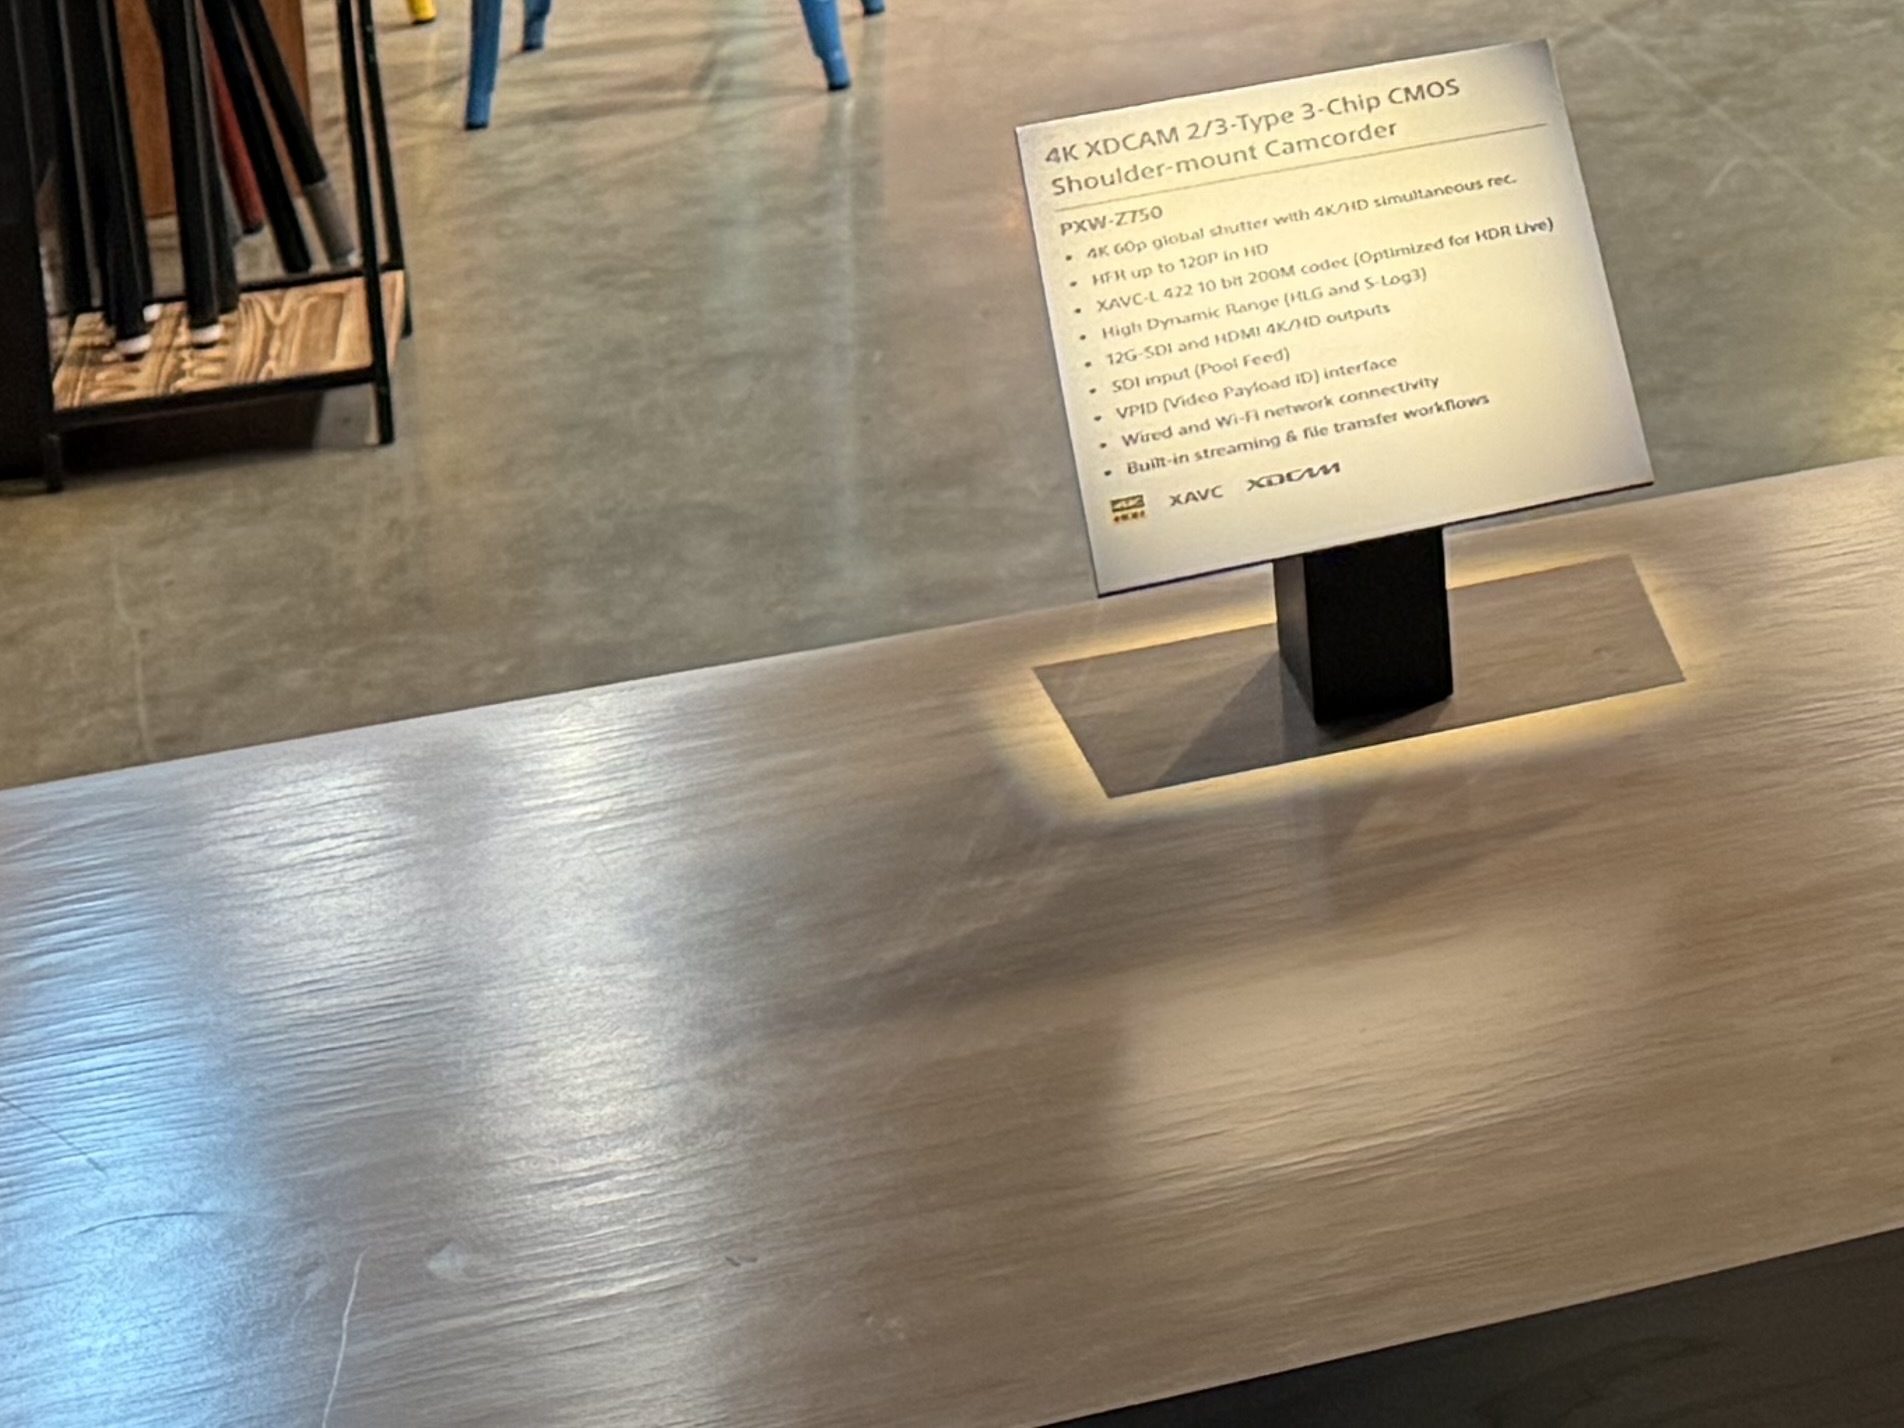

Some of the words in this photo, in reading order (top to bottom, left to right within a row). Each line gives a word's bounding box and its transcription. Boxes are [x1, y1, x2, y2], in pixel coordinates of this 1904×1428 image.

[1043, 142, 1079, 164] 4K
[1083, 125, 1180, 159] XDCAM
[1185, 109, 1295, 141] 2/3-Type
[1300, 92, 1381, 121] 3-Chip
[1386, 76, 1461, 105] CMOS
[1049, 143, 1258, 197] Shoulder-mount
[1263, 121, 1397, 158] Camcorder
[1058, 204, 1163, 237] PXW-Z750
[1447, 233, 1470, 247] for
[1129, 265, 1153, 280] up
[1156, 261, 1176, 274] to
[1178, 250, 1219, 270] 120P
[1222, 249, 1240, 262] in
[1242, 242, 1269, 258] HD
[1100, 320, 1142, 340] High
[1145, 307, 1220, 331] Dynamic
[1224, 296, 1280, 316] Range
[1282, 285, 1324, 308] (HLG
[1327, 278, 1360, 297] and
[1363, 265, 1427, 290] S-Log3)
[1104, 341, 1173, 366] 12G-SDI
[1176, 334, 1210, 353] and
[1213, 324, 1261, 345] HDMI
[1264, 313, 1322, 335] 4K/HD
[1324, 302, 1391, 325] outputs
[1110, 375, 1141, 394] SDI
[1144, 366, 1191, 387] input
[1193, 356, 1239, 380] (Pool
[1241, 345, 1290, 368] Feed)
[1114, 400, 1159, 420] VPID
[1161, 390, 1219, 413] (Video
[1221, 374, 1291, 399] Payload
[1294, 368, 1320, 385] ID)
[1322, 356, 1398, 380] interface
[1119, 424, 1174, 448] Wired
[1177, 417, 1211, 437] and
[1213, 408, 1260, 429] Wi-Fi
[1263, 393, 1335, 419] network
[1337, 375, 1439, 405] connectivity
[1125, 453, 1190, 475] Built-in
[1193, 434, 1282, 462] streaming
[1284, 428, 1298, 443] &
[1301, 424, 1329, 440] file
[1332, 411, 1398, 434] transfer
[1402, 393, 1490, 420] workflows
[1168, 484, 1224, 508] XAVC
[1246, 460, 1341, 492] XDCAM
